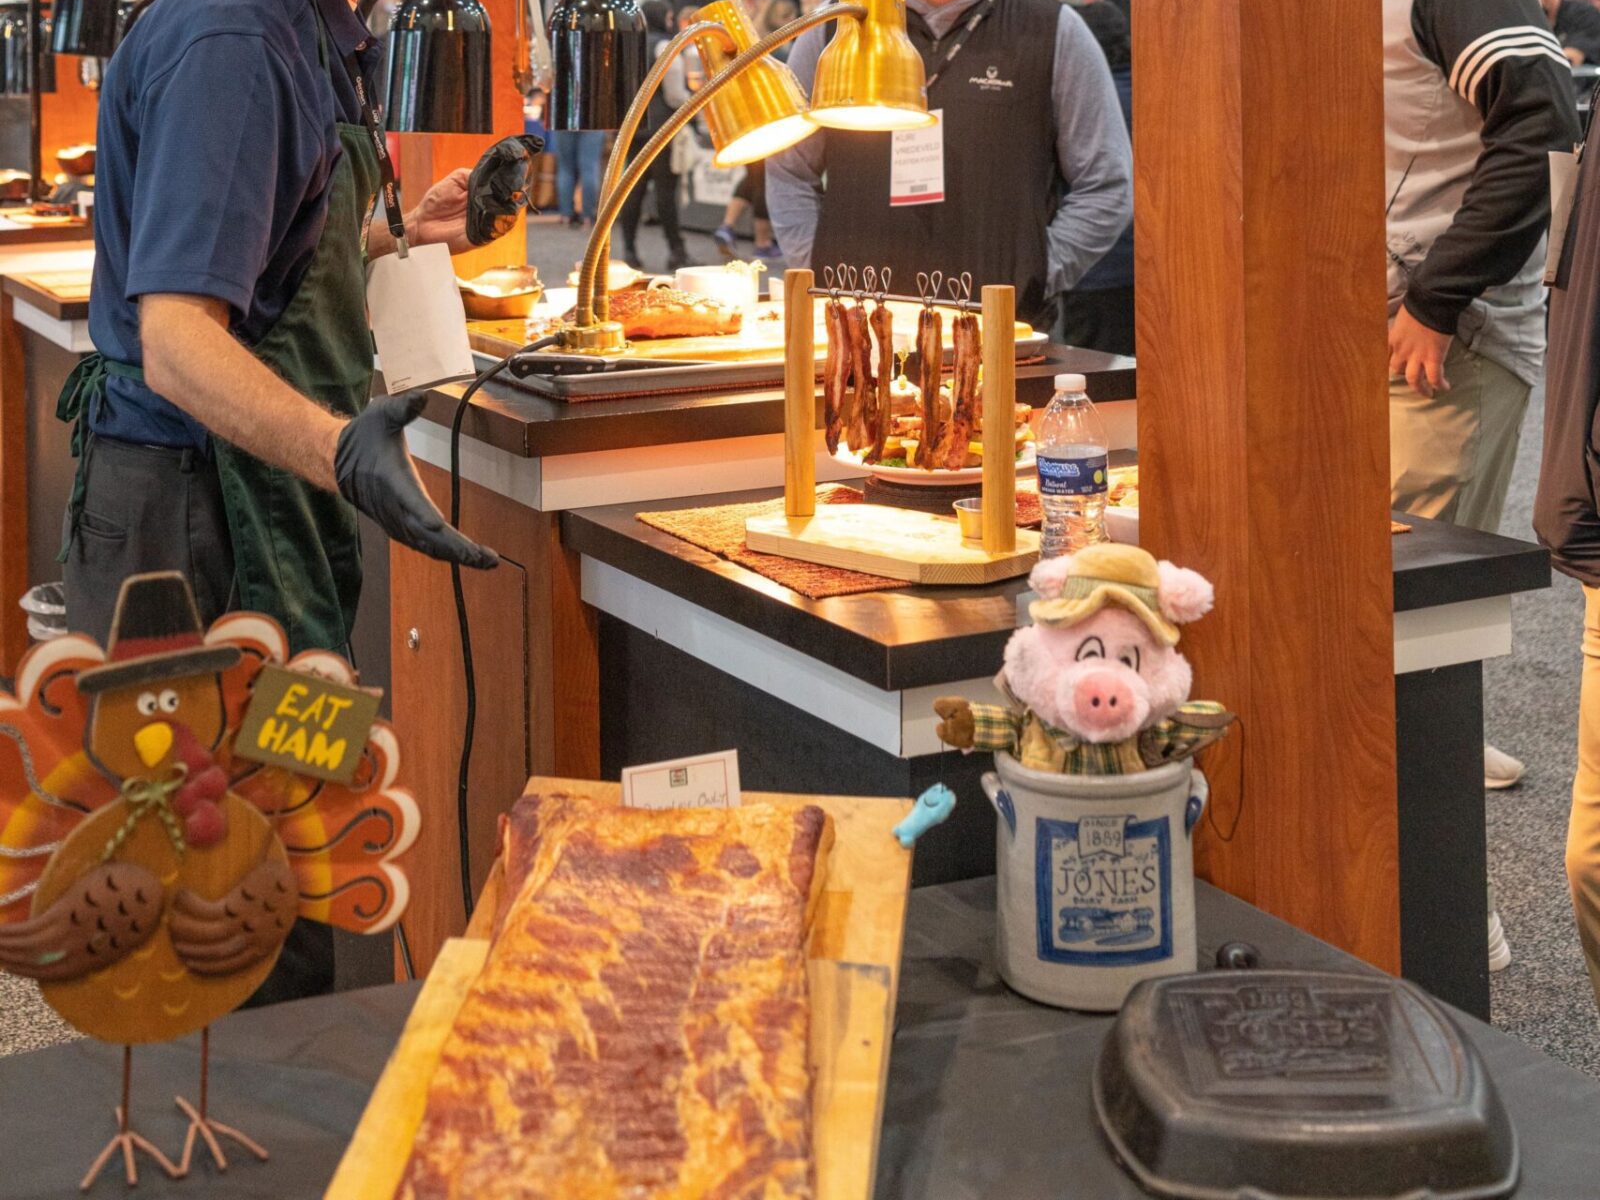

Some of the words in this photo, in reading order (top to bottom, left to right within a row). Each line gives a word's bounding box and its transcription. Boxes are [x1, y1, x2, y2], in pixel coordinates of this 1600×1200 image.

[275, 683, 353, 731] EAT
[257, 717, 347, 771] HAM
[1083, 819, 1118, 828] SINCE
[1085, 830, 1122, 848] 1889
[1057, 865, 1157, 897] JONES
